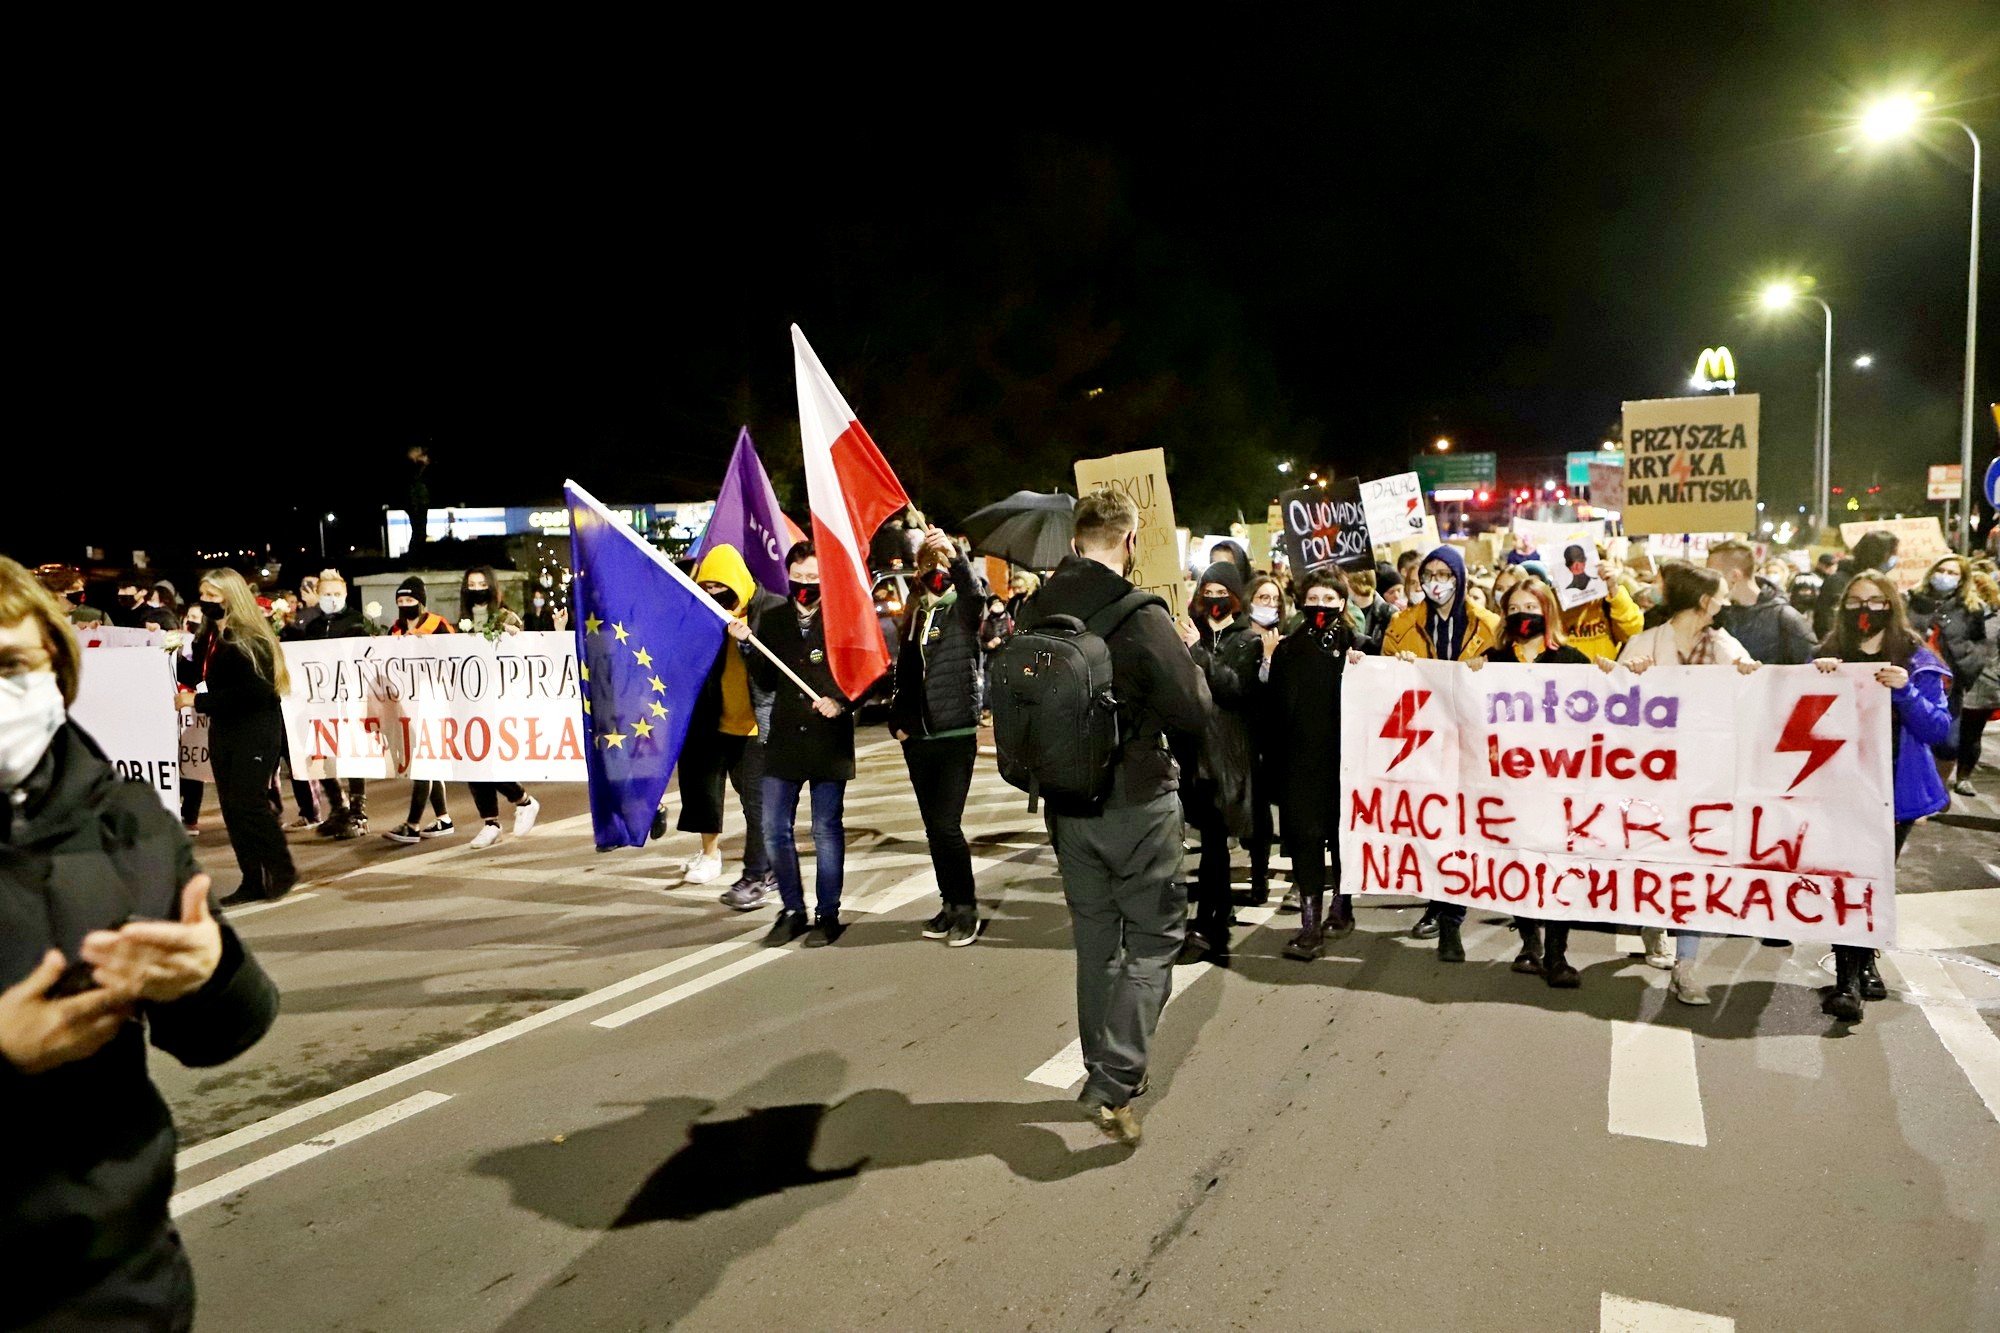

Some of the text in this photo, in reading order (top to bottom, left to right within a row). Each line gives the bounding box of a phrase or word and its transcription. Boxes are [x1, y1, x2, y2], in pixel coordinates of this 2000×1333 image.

[1630, 424, 1747, 454] PRZYSZŁA
[1290, 500, 1332, 536] QUO
[1628, 484, 1654, 505] NA
[1302, 527, 1368, 562] POLSKO?
[302, 646, 488, 703] PAŃSTWO
[1487, 680, 1680, 728] młoda
[309, 716, 584, 774] NIE JAROSŁA
[1488, 733, 1678, 781] lewica
[1350, 787, 1809, 870] MACIE KREW
[1361, 842, 1874, 932] NA SWOICH RĘKACH
